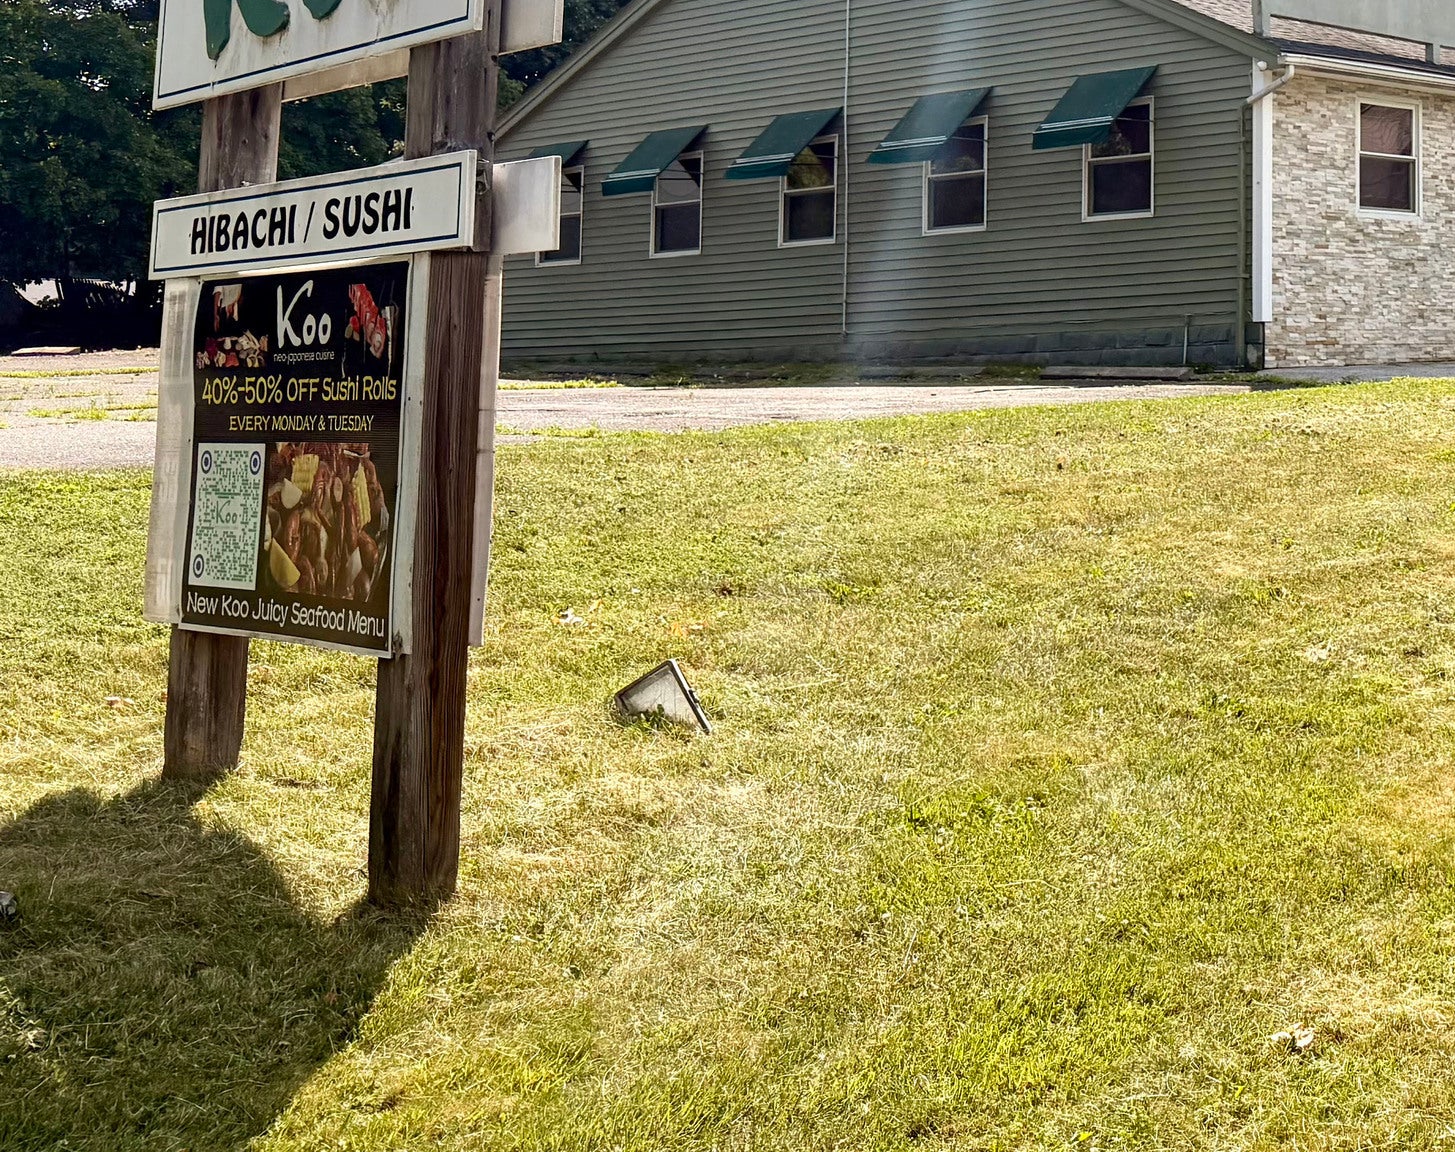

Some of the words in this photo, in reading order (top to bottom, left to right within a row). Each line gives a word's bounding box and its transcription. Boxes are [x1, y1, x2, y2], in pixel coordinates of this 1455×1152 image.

[190, 204, 297, 255] HIBACHI
[303, 201, 316, 243] /
[322, 188, 413, 240] SUSHI
[276, 280, 332, 348] Koo
[202, 374, 283, 405] 40%-50%
[286, 377, 320, 402] OFF
[321, 375, 359, 402] Sushi
[362, 375, 397, 401] Rolls
[228, 415, 271, 431] EVERY
[271, 415, 316, 431] MONDAY
[317, 415, 326, 431] &
[327, 415, 374, 431] TUESDAY
[216, 499, 238, 524] Koo
[186, 591, 218, 616] New
[221, 595, 249, 618] Koo
[252, 598, 289, 627] Juicy
[290, 603, 345, 631] Seafood
[347, 609, 385, 638] Menu
